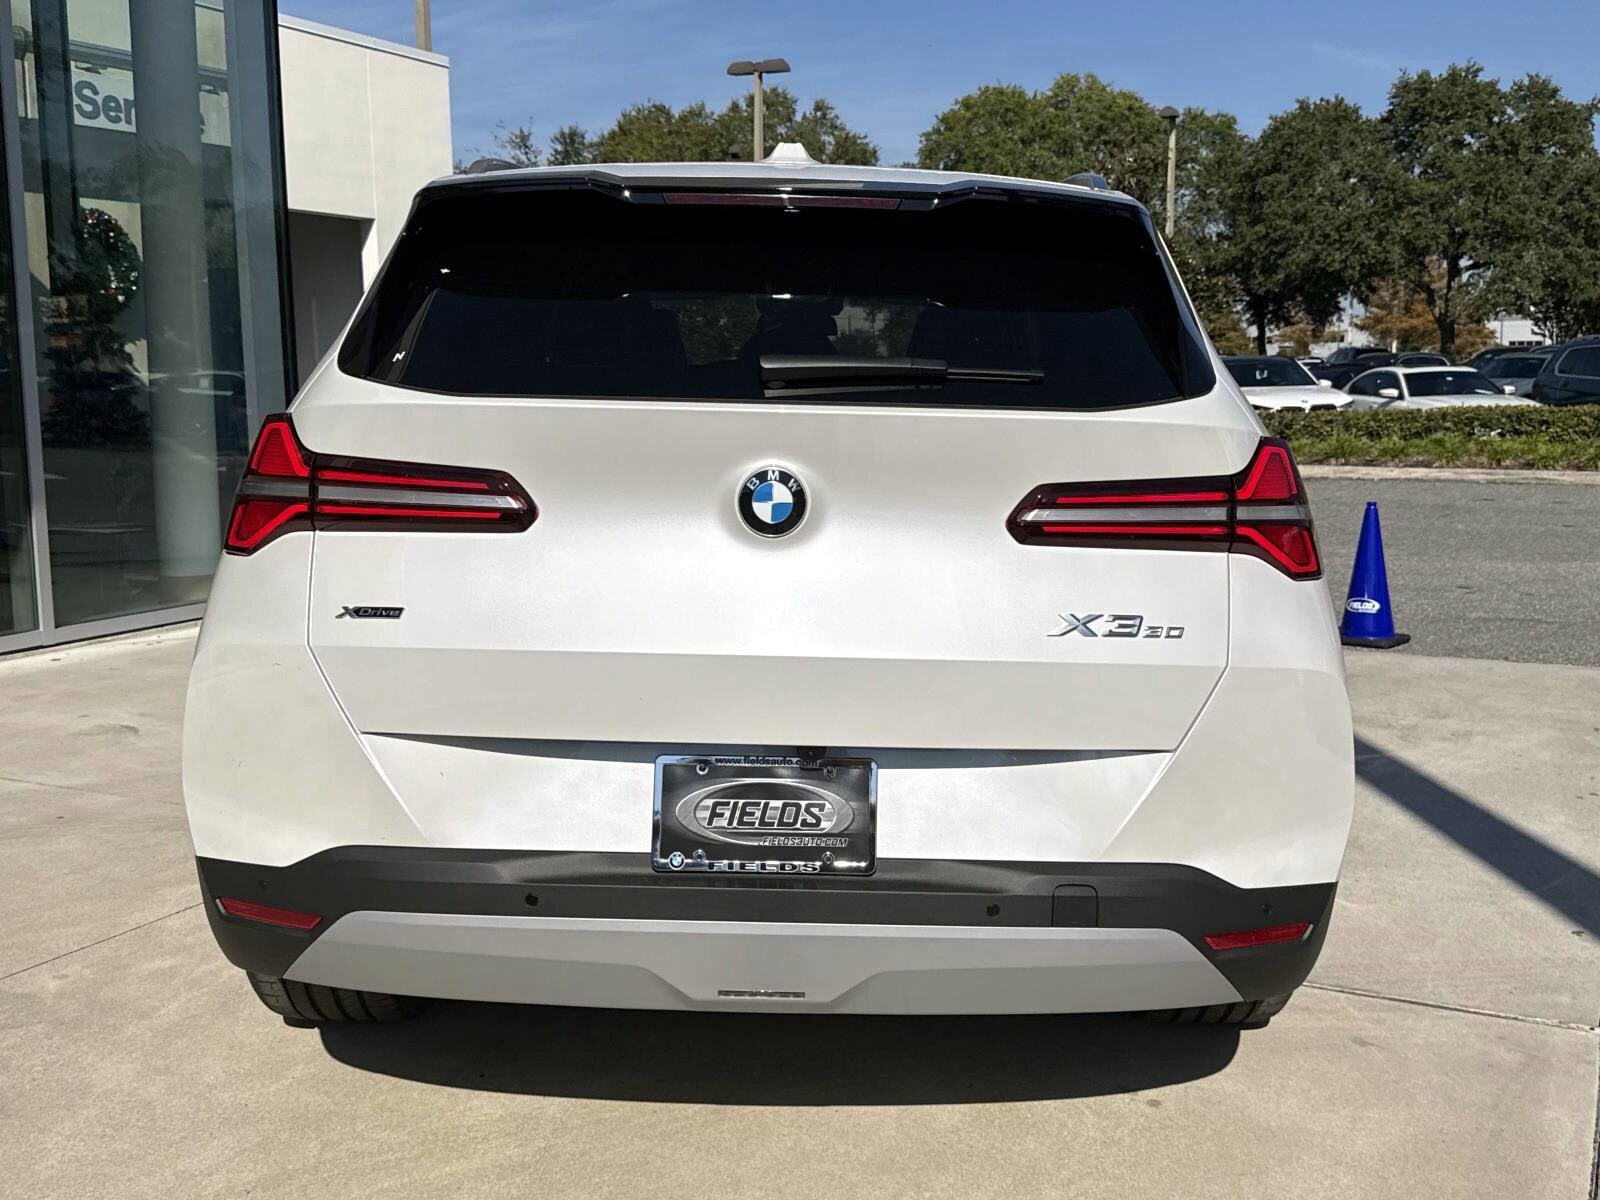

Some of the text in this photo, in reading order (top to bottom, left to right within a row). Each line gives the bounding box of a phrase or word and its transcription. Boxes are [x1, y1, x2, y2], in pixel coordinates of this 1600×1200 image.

[746, 469, 802, 493] BMW
[714, 756, 820, 769] www.fieldsauto.com
[706, 800, 826, 829] FIELDS
[707, 861, 820, 873] FIELDS
